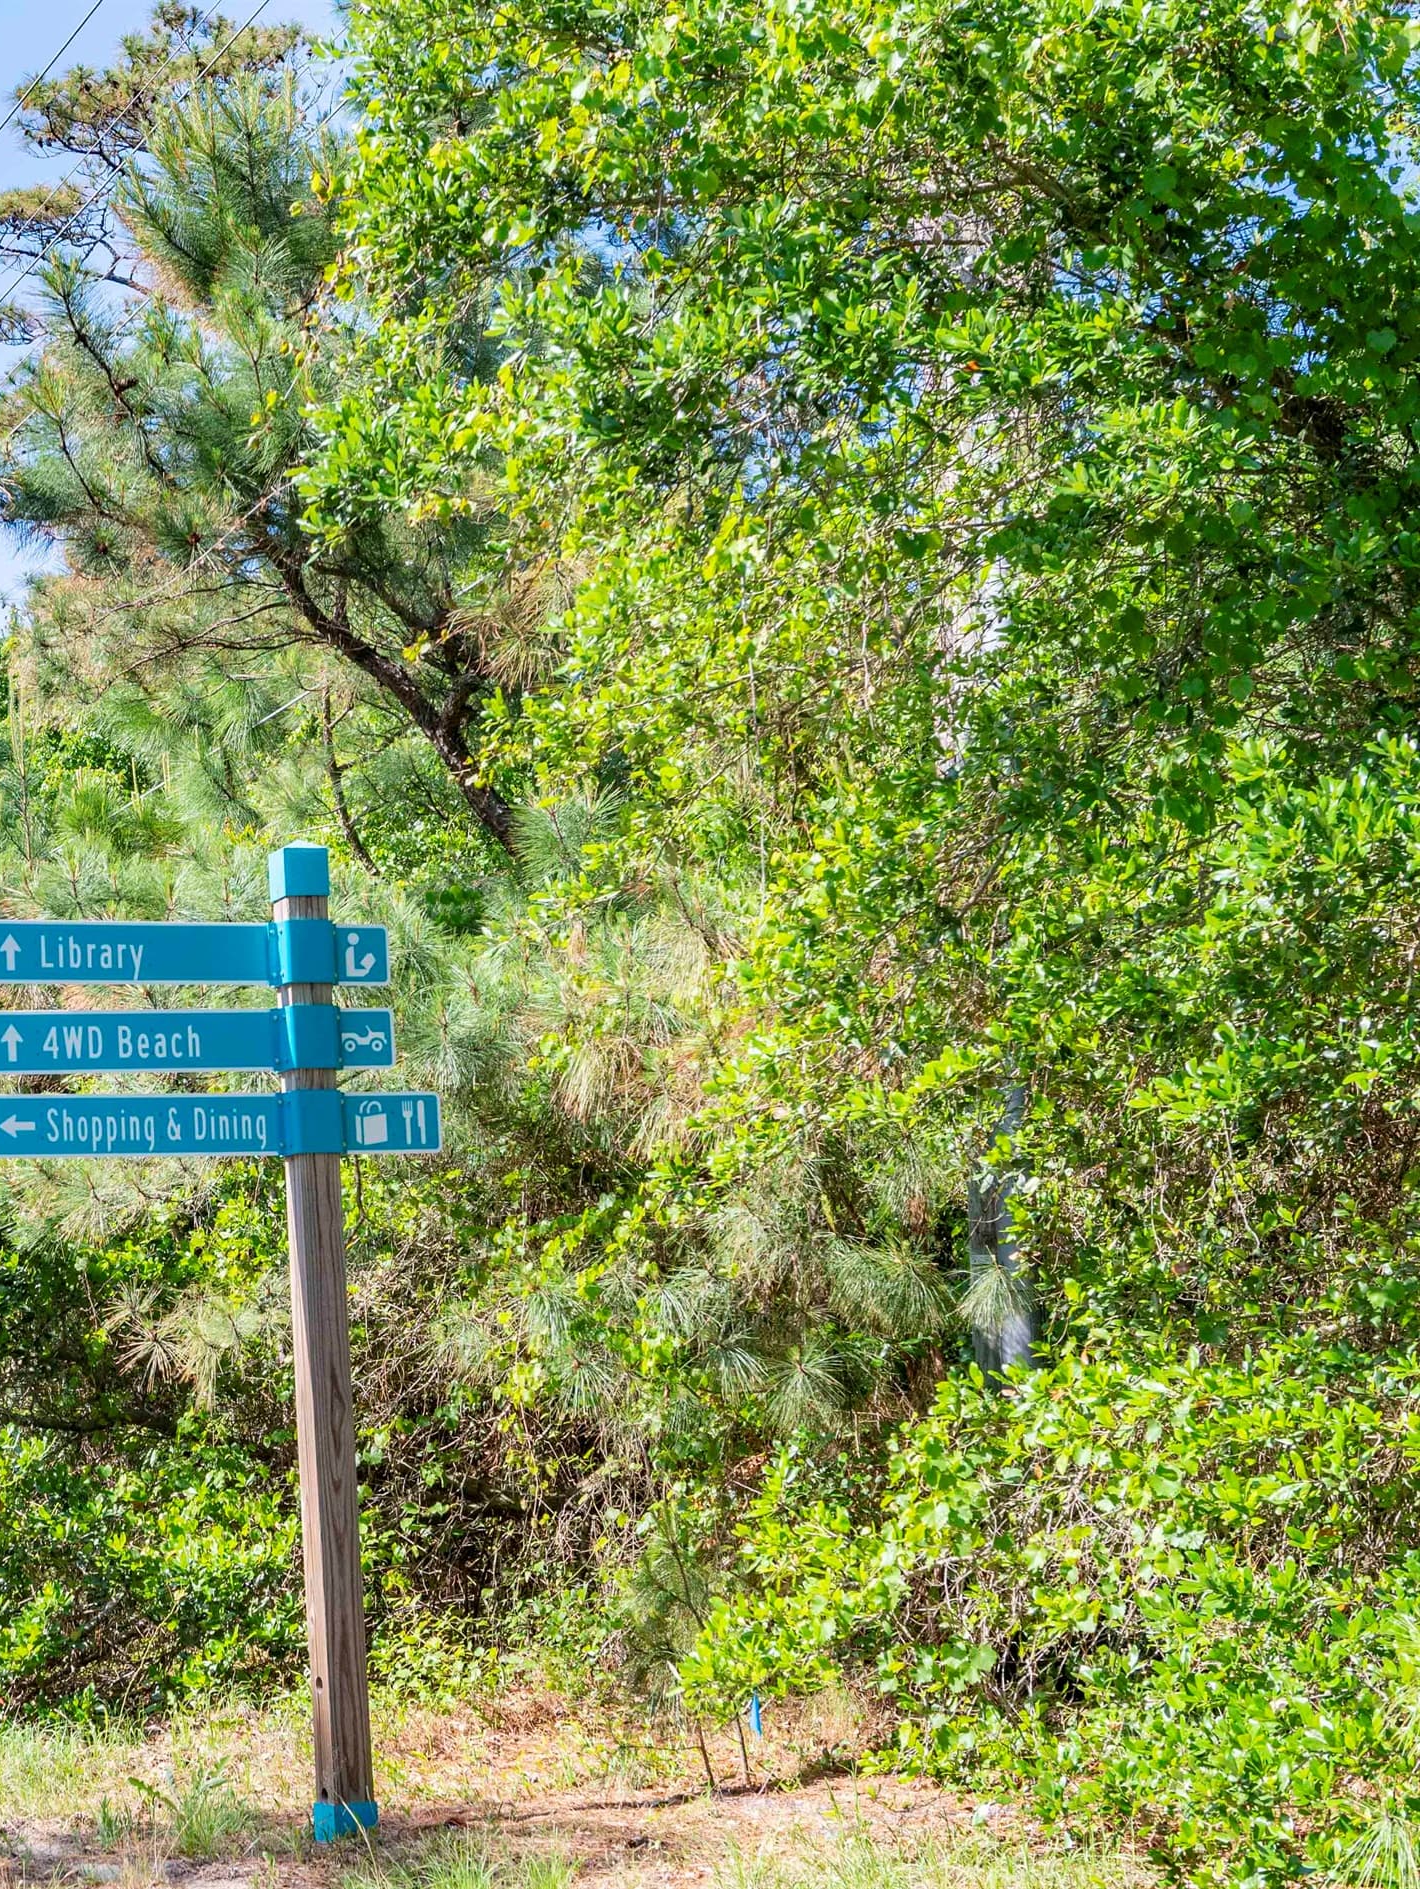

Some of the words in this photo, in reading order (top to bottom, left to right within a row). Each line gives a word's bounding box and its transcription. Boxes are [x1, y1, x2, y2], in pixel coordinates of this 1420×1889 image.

[40, 935, 144, 981] Library
[43, 1026, 103, 1060] 4WD
[117, 1024, 201, 1059] Beach
[47, 1107, 154, 1152] Shopping
[167, 1107, 182, 1140] &
[194, 1107, 267, 1150] Dining
